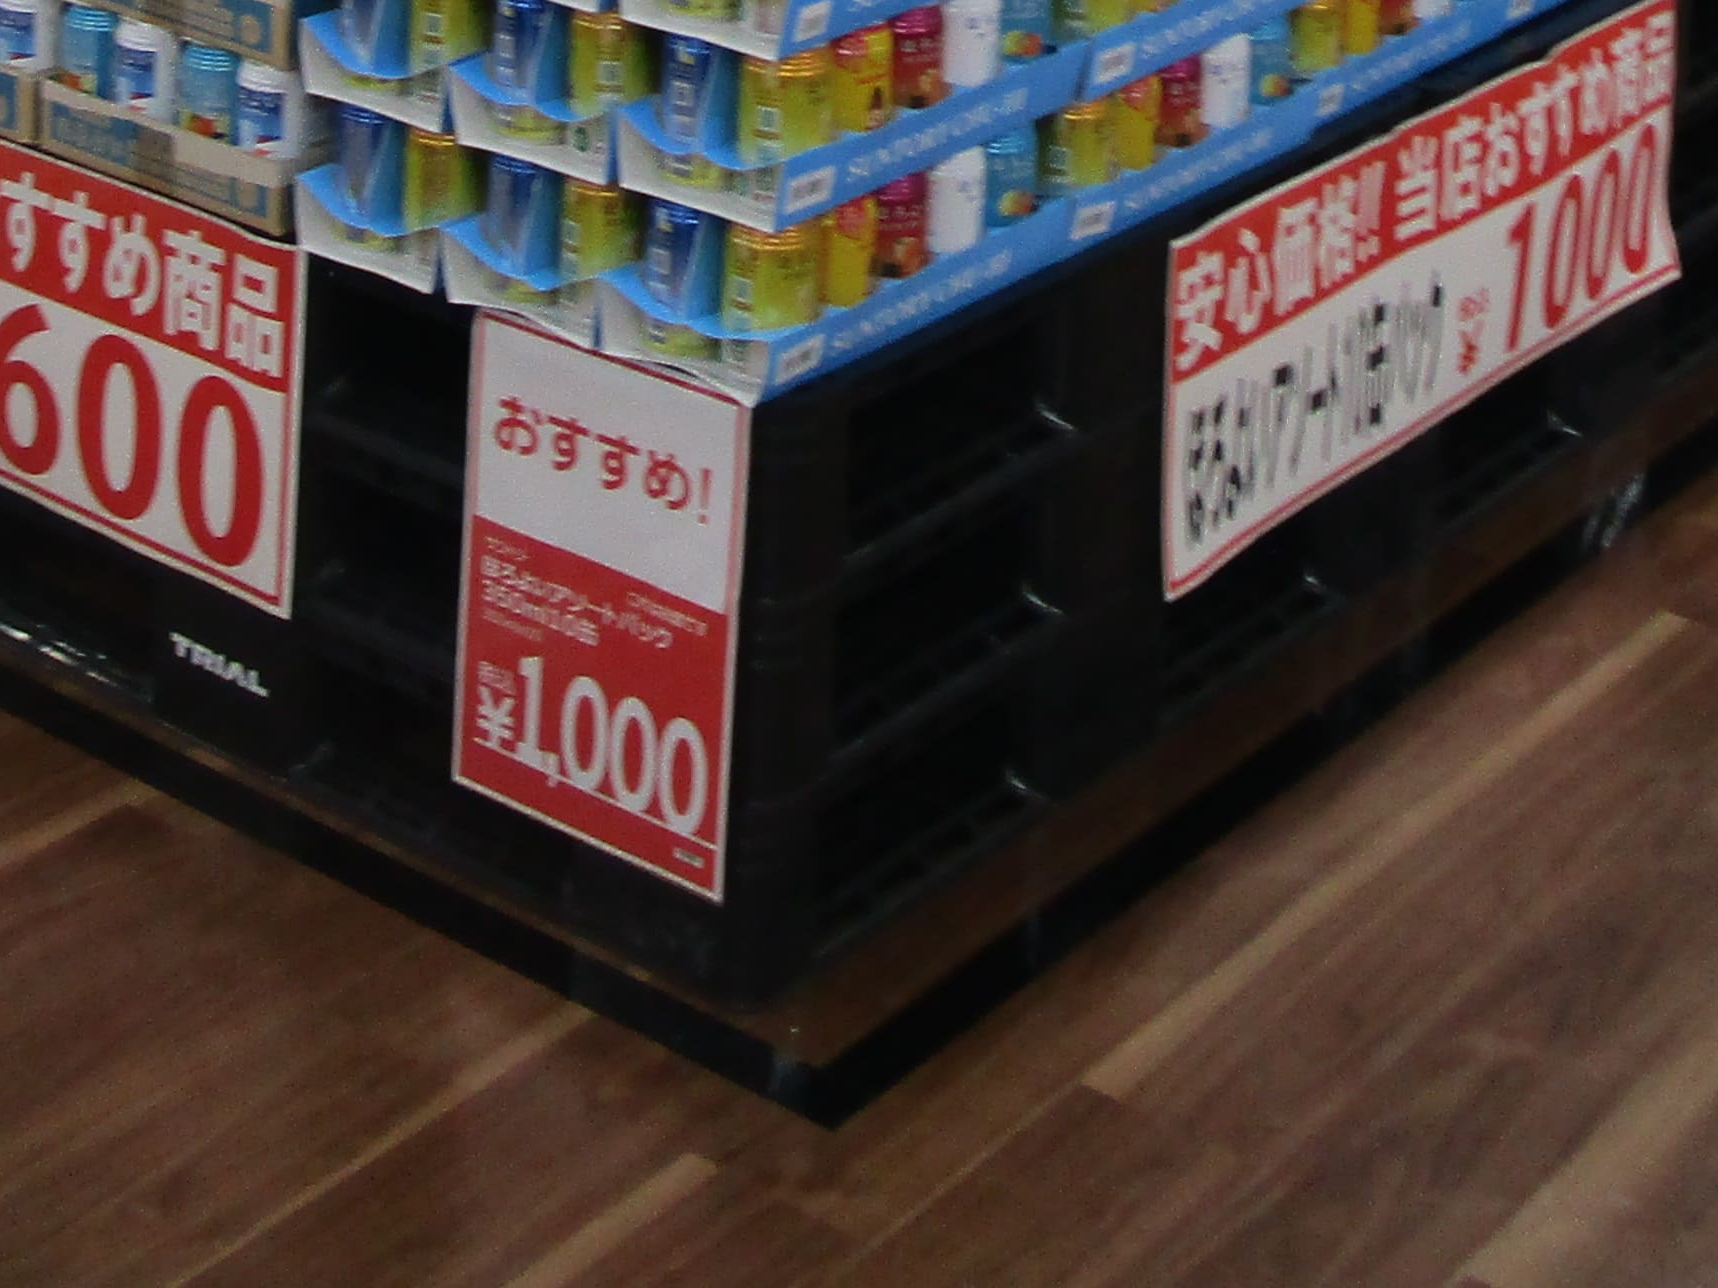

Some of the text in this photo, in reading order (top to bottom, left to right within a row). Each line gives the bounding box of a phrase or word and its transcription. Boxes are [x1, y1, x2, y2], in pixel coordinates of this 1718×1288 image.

[1392, 11, 1677, 244] 当店おすすめ商品
[492, 394, 713, 525] おすすめ!
[169, 630, 270, 699] TRIAL
[480, 552, 675, 650] ほろよいアソートパック
[475, 654, 710, 839] ¥1,000
